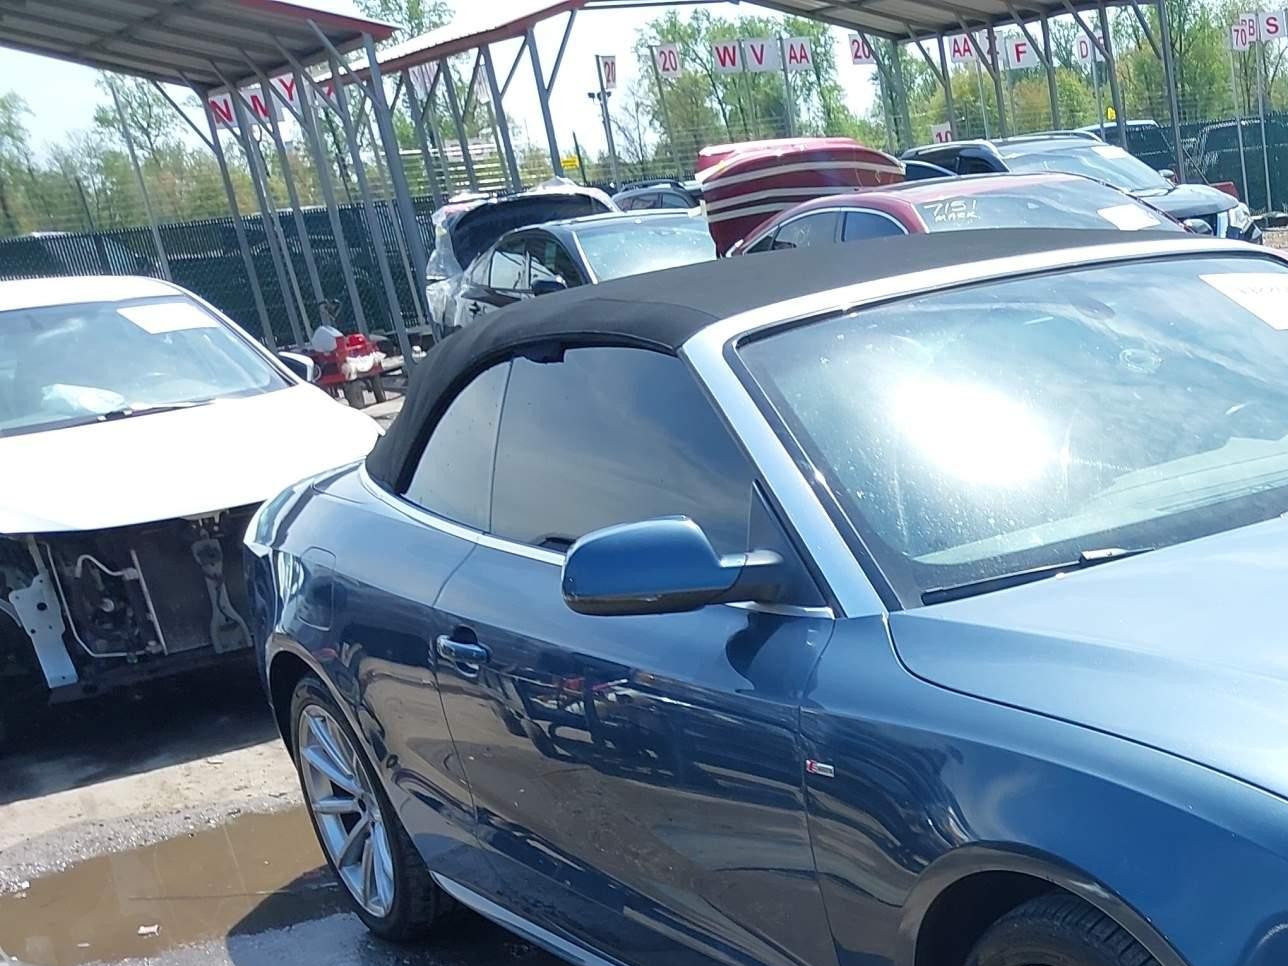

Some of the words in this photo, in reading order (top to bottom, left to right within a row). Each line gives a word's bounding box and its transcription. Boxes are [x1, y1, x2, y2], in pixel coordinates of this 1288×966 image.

[1266, 16, 1279, 34] S
[952, 37, 972, 58] AA
[1233, 28, 1247, 47] 70
[715, 44, 736, 67] W
[750, 43, 765, 65] V
[789, 42, 810, 64] AA
[1014, 43, 1027, 63] F
[1080, 40, 1089, 58] D
[604, 61, 616, 83] 20
[660, 50, 678, 72] 20
[279, 78, 296, 101] Y
